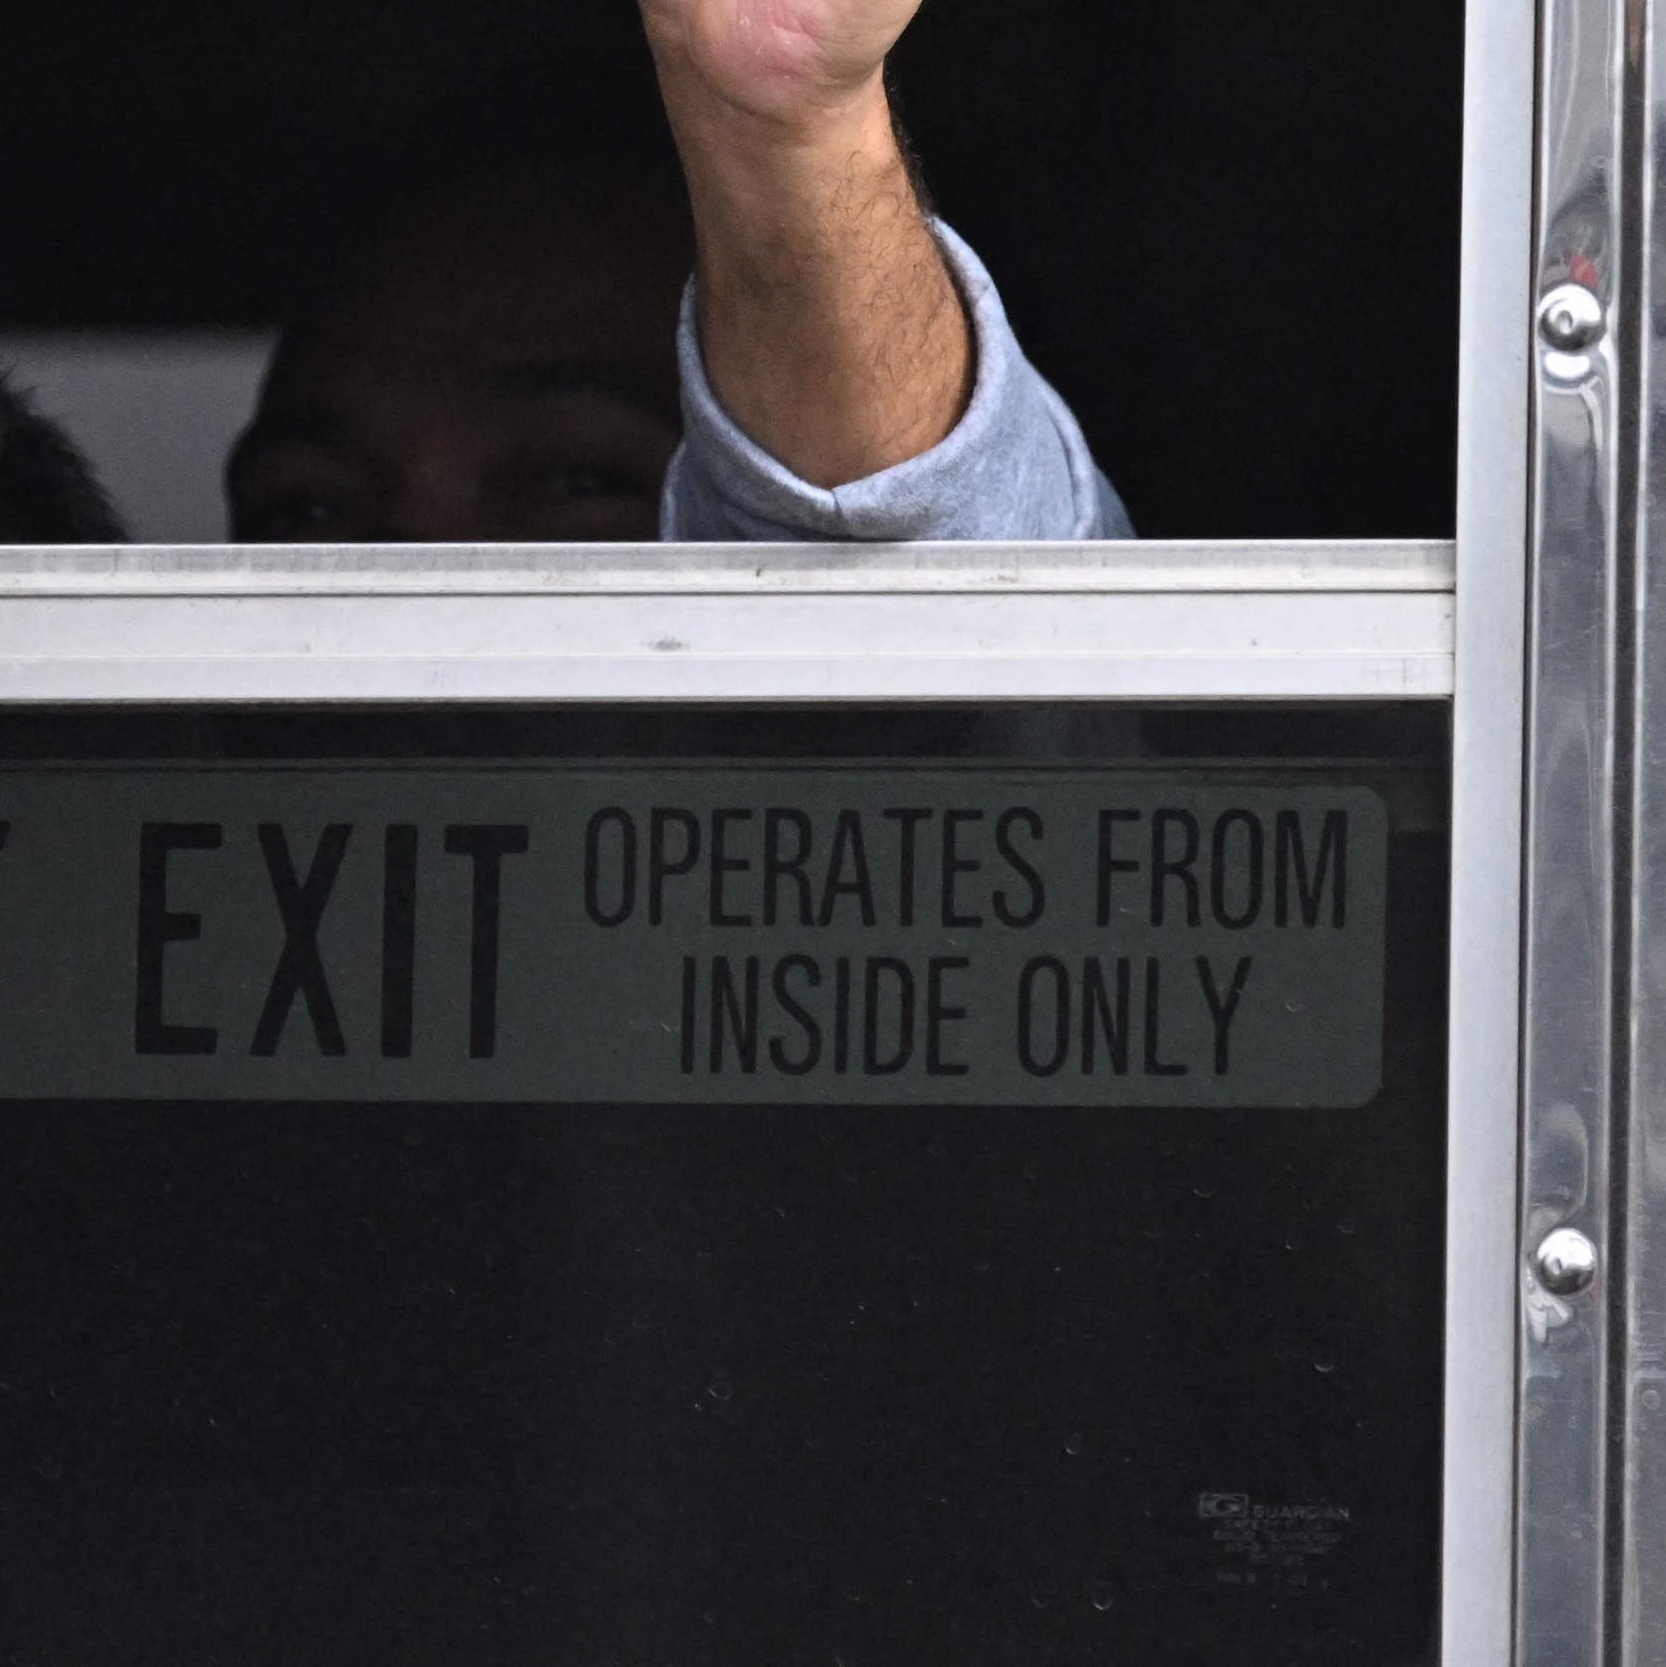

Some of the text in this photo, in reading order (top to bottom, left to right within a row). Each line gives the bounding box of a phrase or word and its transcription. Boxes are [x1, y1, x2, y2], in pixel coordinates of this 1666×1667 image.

[582, 806, 1349, 932] OPERATES FROM
[133, 821, 530, 1060] EXIT
[679, 954, 1253, 1078] INSIDE ONLY
